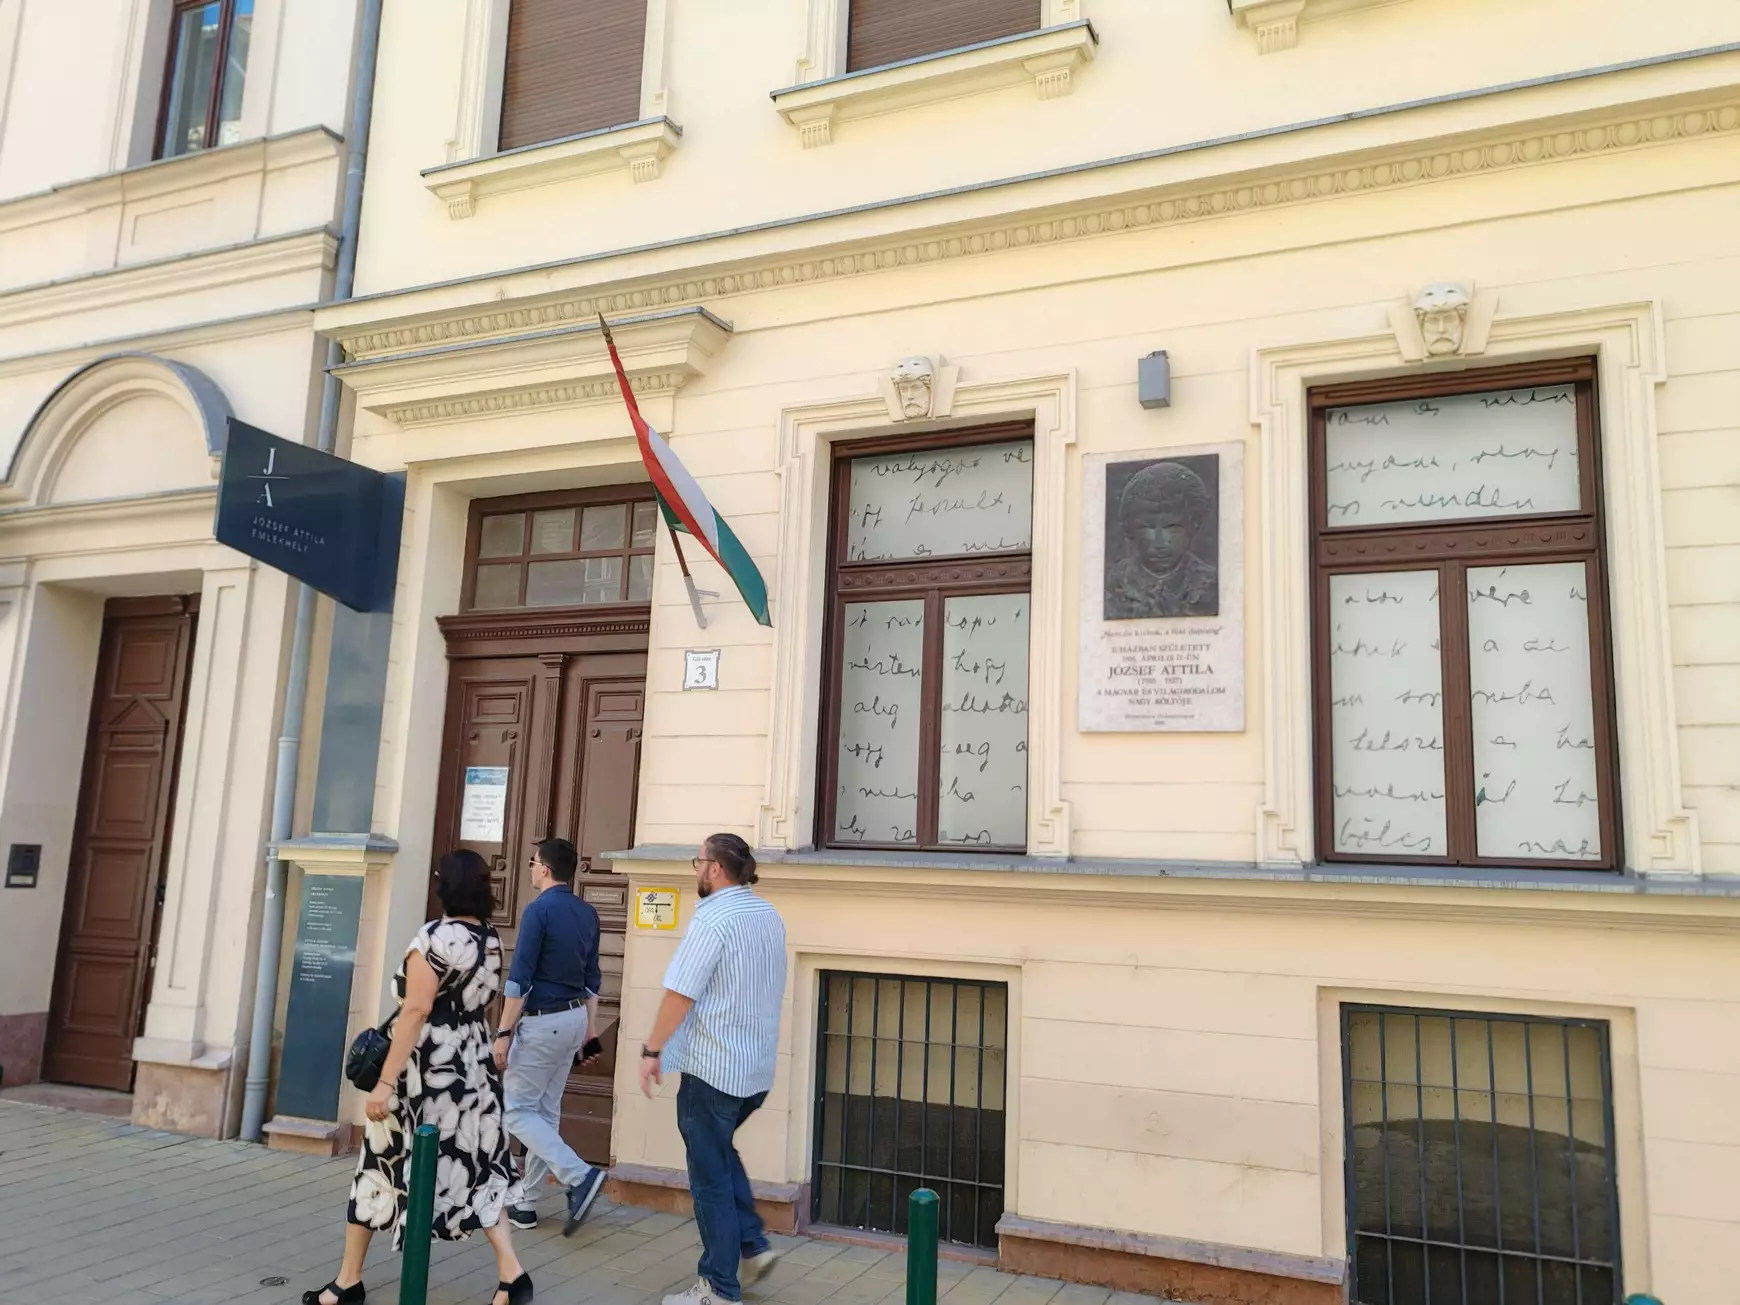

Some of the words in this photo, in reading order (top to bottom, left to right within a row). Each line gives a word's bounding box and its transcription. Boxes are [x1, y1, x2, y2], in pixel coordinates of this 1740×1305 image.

[262, 447, 277, 475] J
[256, 482, 274, 508] A
[293, 526, 326, 545] ATTILA
[694, 665, 706, 683] 3
[1107, 663, 1157, 679] JÓZSEF
[1160, 663, 1215, 676] ATTILA
[1104, 688, 1140, 696] MAGYAR
[1127, 697, 1152, 706] NAGY
